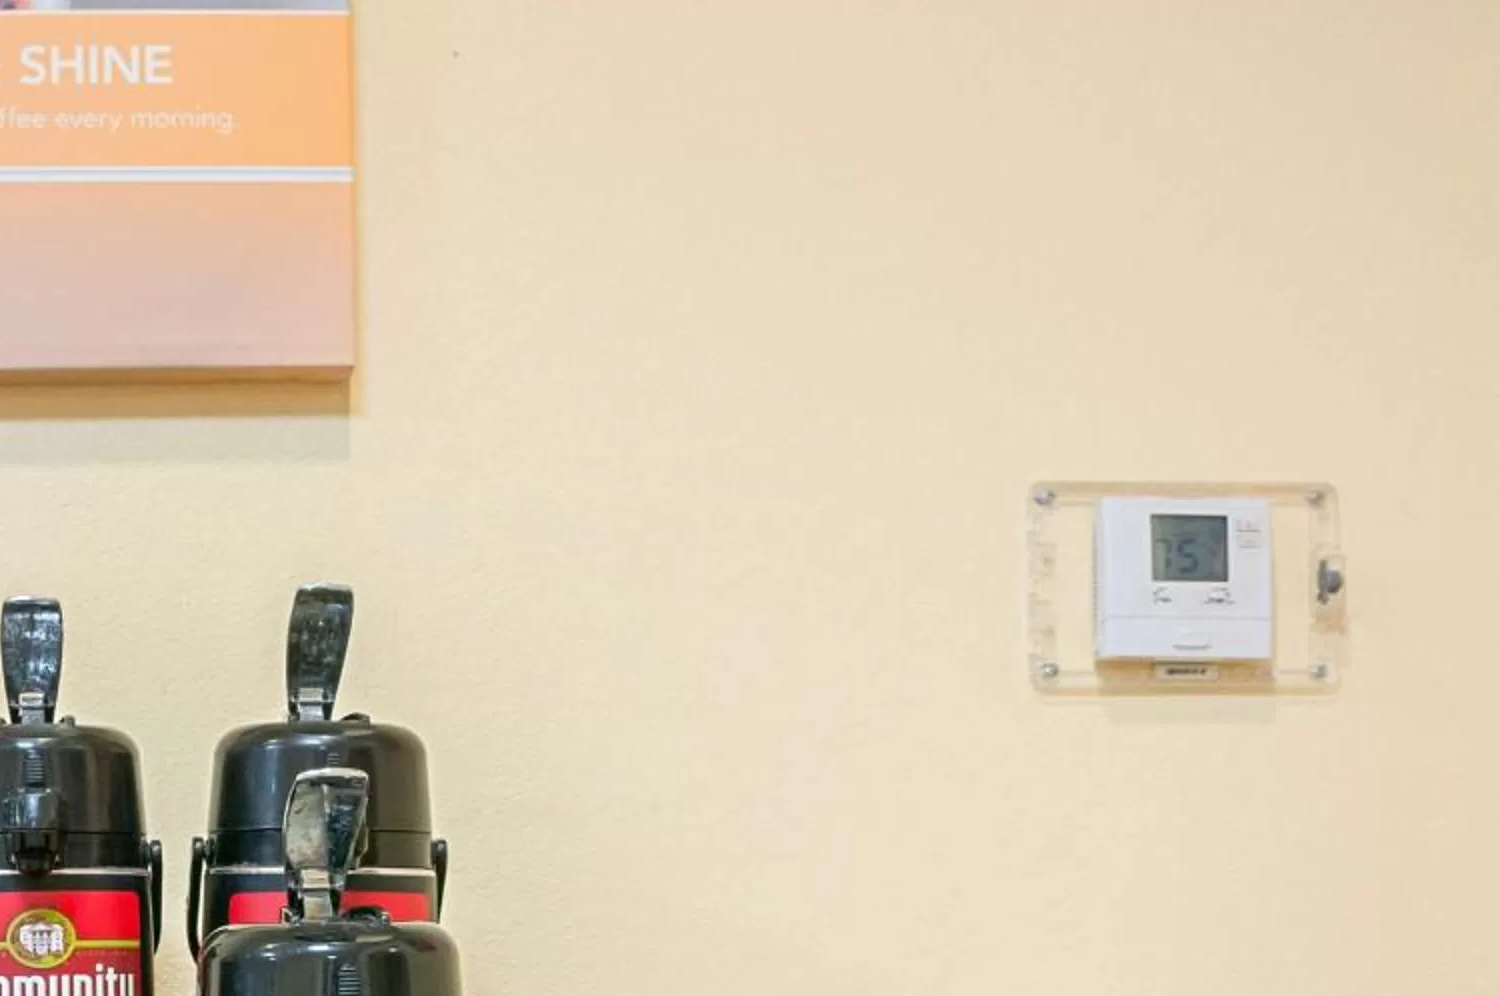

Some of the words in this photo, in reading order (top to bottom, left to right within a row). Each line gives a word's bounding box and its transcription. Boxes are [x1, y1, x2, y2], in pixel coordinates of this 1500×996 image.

[18, 43, 173, 86] SHINE
[54, 109, 124, 134] every
[131, 104, 234, 135] morning
